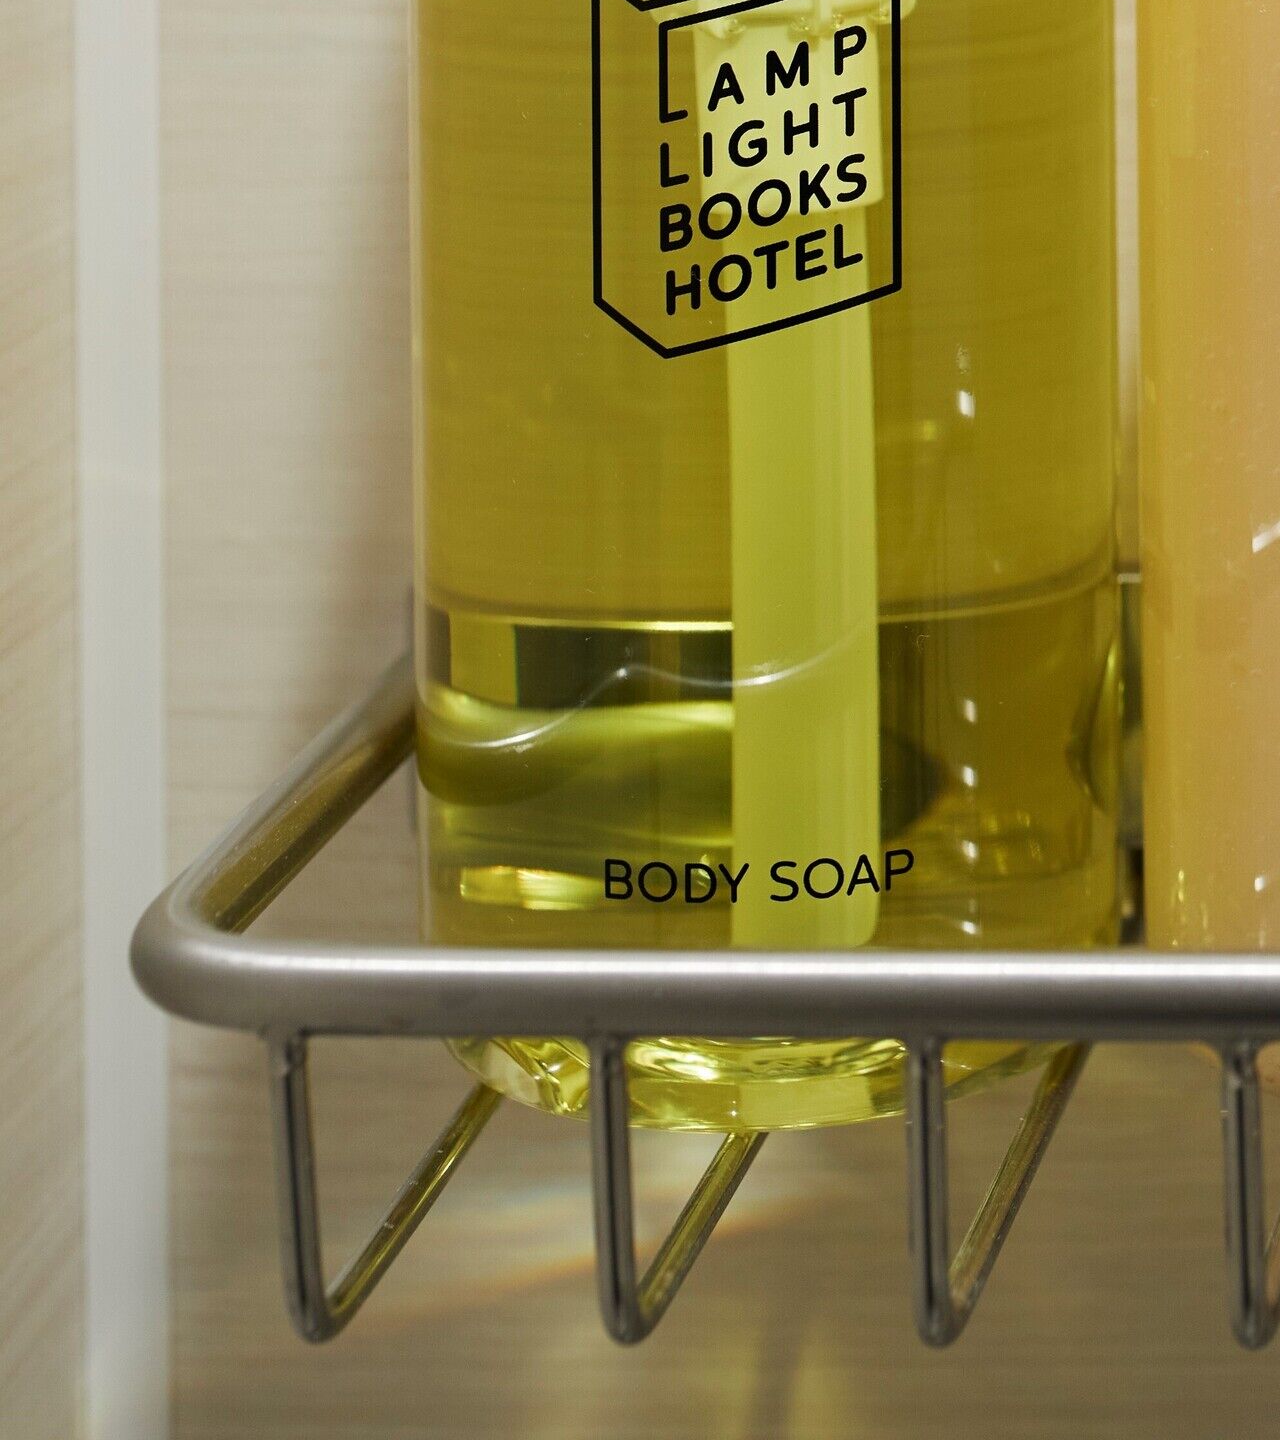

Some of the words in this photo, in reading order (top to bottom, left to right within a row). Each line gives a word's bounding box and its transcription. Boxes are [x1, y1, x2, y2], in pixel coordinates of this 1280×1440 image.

[659, 22, 867, 123] LAMP
[660, 87, 867, 188] LIGHT
[659, 153, 867, 252] BOOKS
[666, 223, 863, 315] HOTEL
[604, 858, 750, 903] BODY
[769, 848, 915, 902] SOAP
